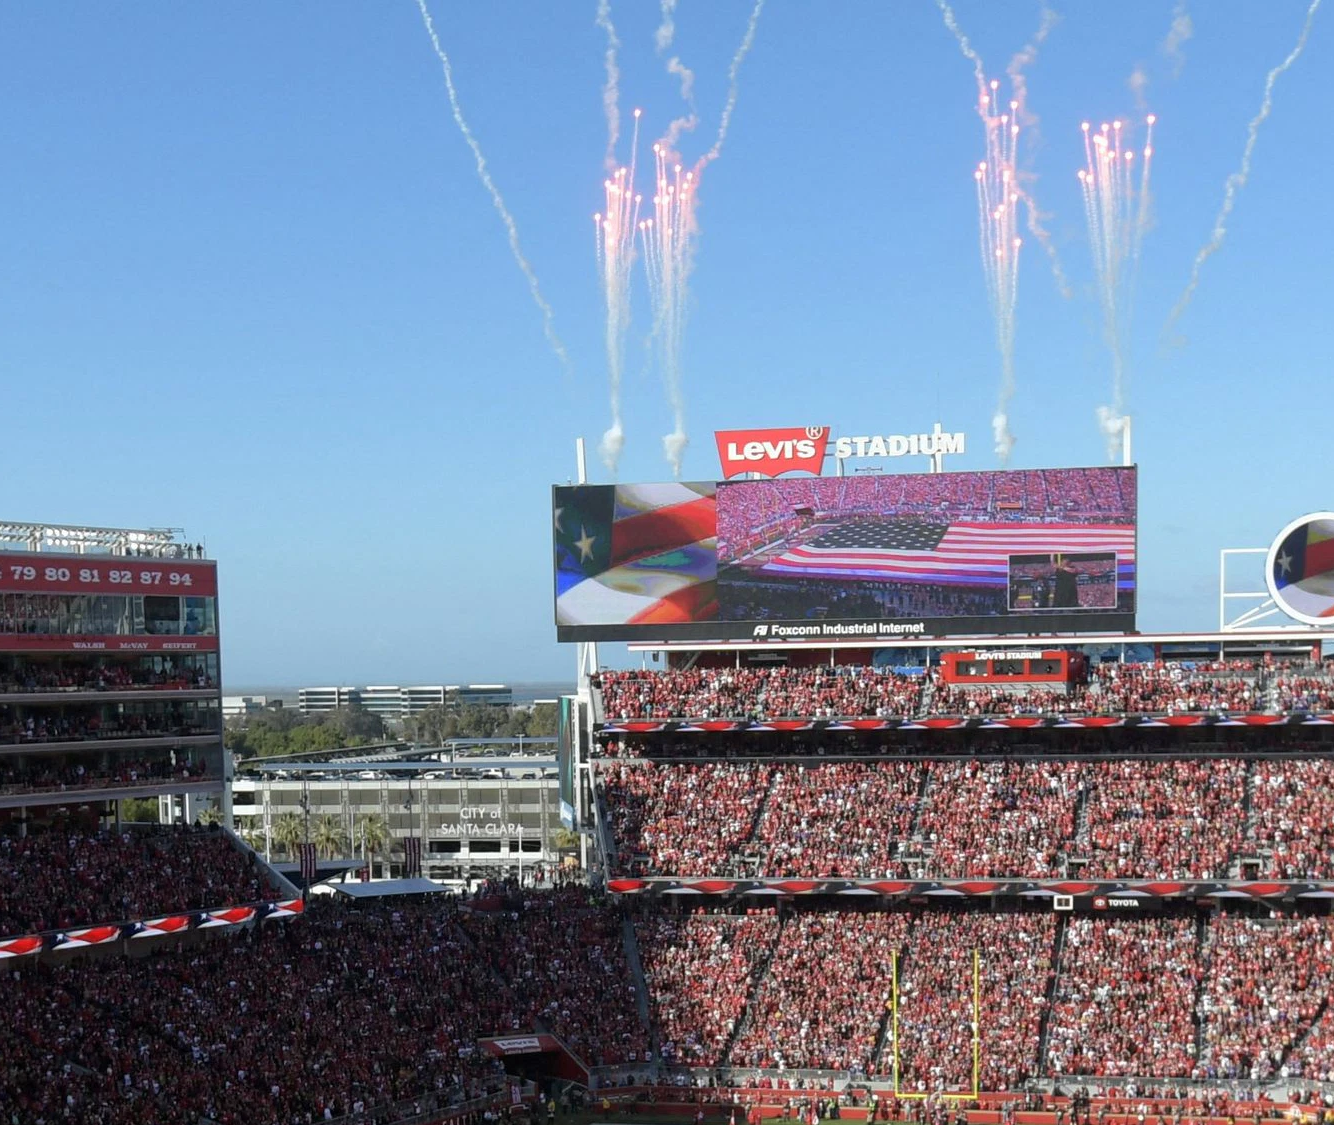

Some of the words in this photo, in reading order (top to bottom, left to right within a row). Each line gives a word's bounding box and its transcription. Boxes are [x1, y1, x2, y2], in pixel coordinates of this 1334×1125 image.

[835, 432, 965, 459] STADIUM
[10, 565, 37, 580] 79
[44, 567, 70, 582] 80
[79, 568, 101, 583] 81
[108, 569, 133, 584] 82
[140, 570, 163, 585] 87
[169, 572, 193, 586] 94
[771, 624, 821, 636] Foxconn
[822, 623, 877, 635] Industrial
[878, 622, 925, 634] Internet
[1006, 651, 1042, 660] STADIUM
[460, 807, 486, 819] CITY
[490, 807, 502, 819] of
[441, 823, 480, 835] SANTA
[485, 823, 524, 835] CLARA
[1108, 899, 1140, 907] TOYOTA
